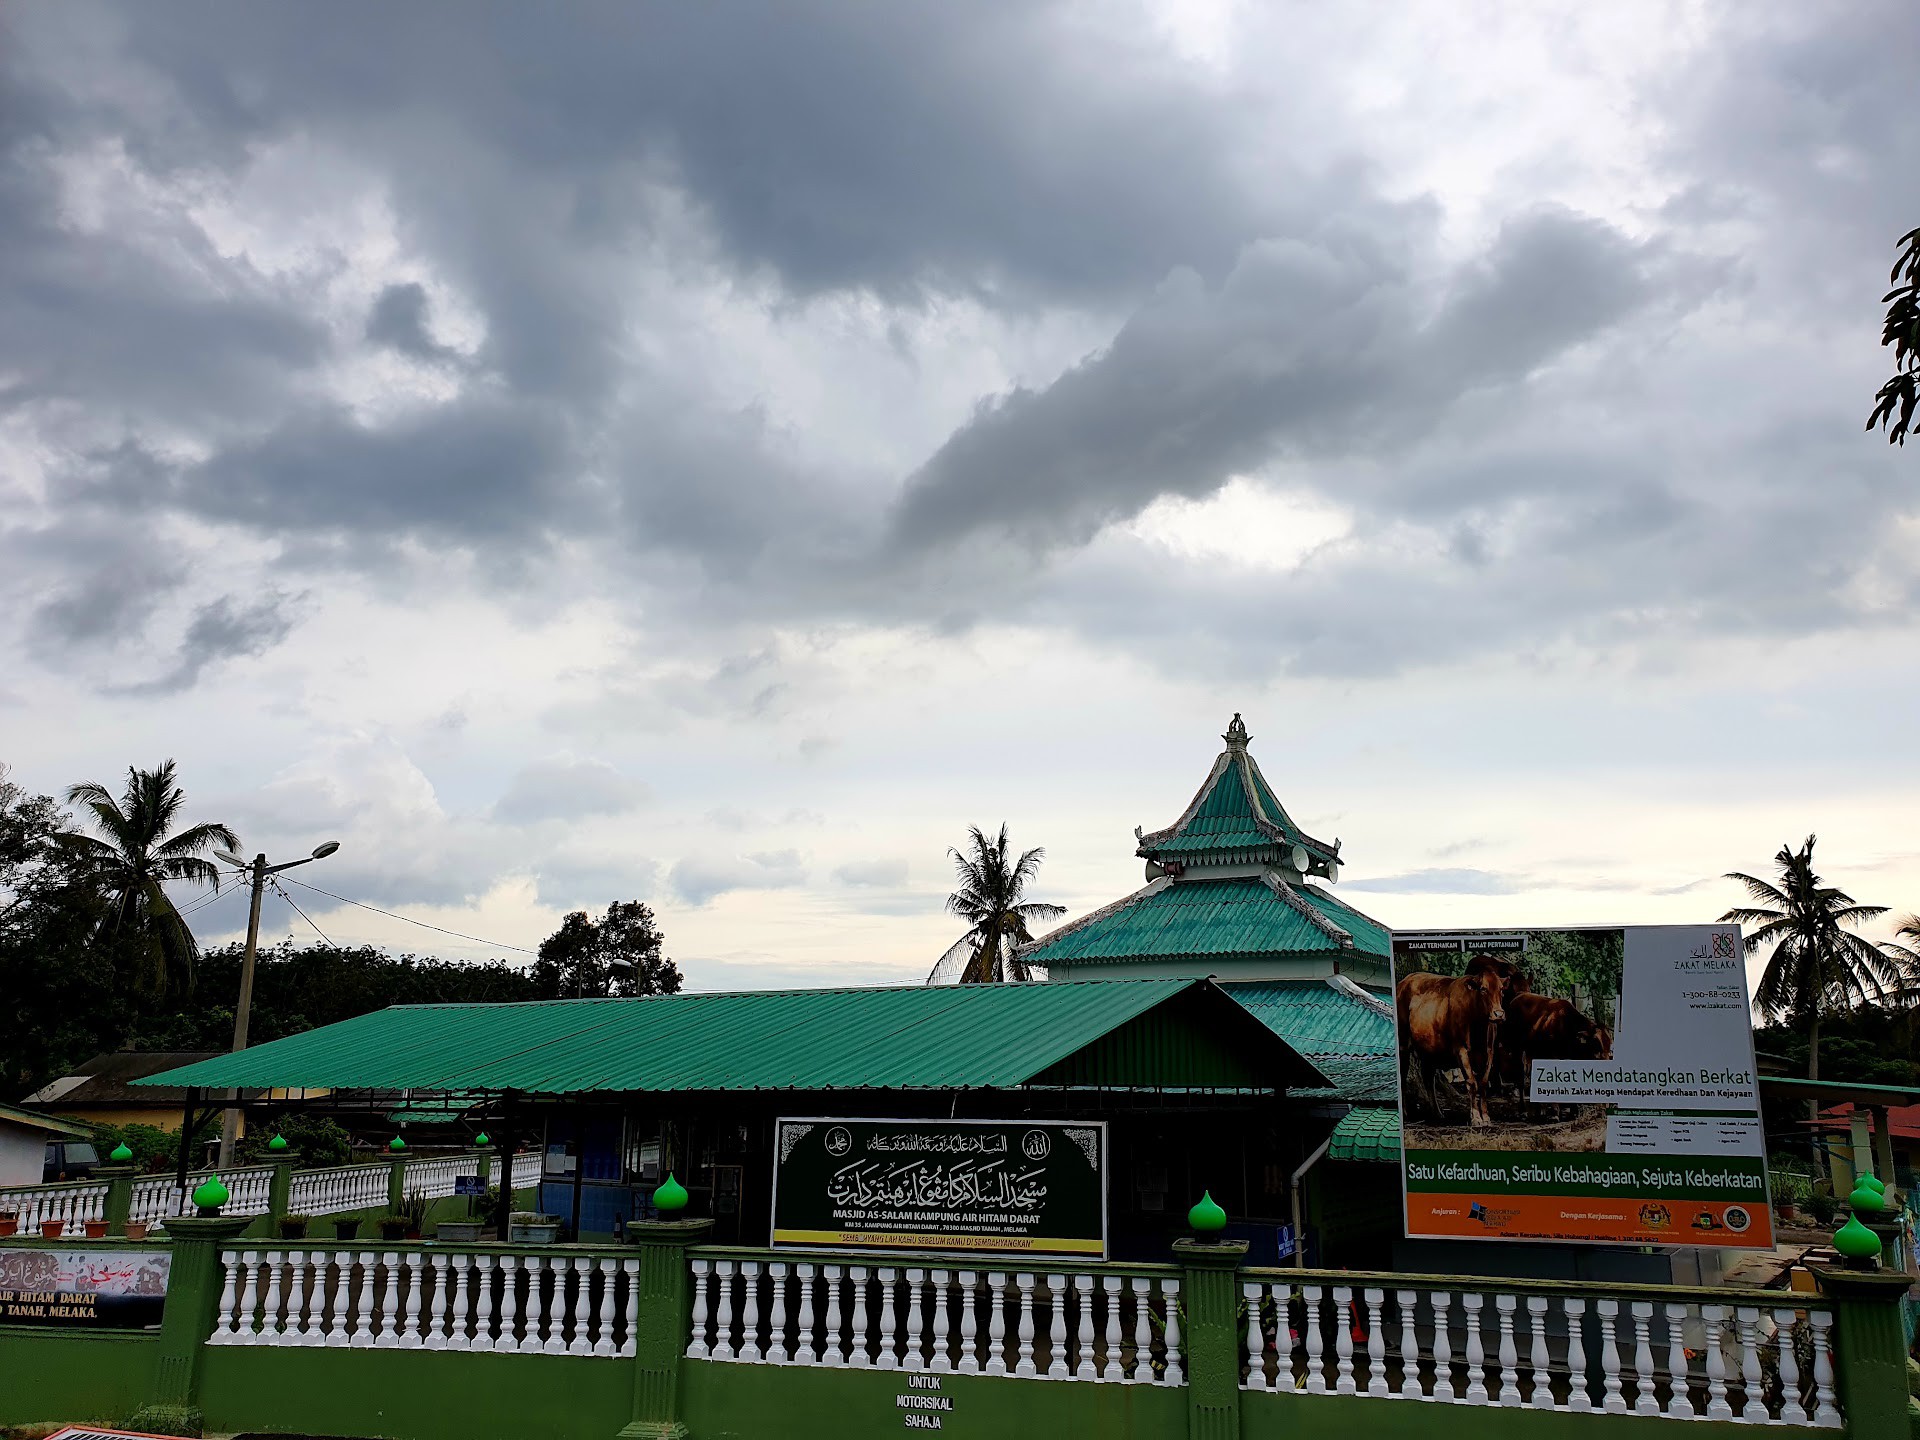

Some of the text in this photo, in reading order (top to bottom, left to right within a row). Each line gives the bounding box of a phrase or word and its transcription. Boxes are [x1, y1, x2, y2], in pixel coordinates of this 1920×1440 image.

[1674, 960, 1737, 970] ZAKAT MELAKA
[1682, 991, 1740, 999] 1-300-88-0233
[1536, 1067, 1752, 1086] Zakat Mendatangkan Berkat
[1571, 1087, 1593, 1096] Zakat
[1594, 1088, 1615, 1097] Moga
[1617, 1088, 1654, 1098] Mendapat
[1656, 1088, 1698, 1097] Keredhaan
[1700, 1089, 1715, 1097] Dan
[1717, 1089, 1753, 1099] Kejayaan
[1408, 1163, 1762, 1190] Satu Kefardhuan, Seribu Kebahagiaan, Sejuta Keberkatan
[833, 1209, 1040, 1224] MASJID AS-SALAM KAMPUNG AIR HITAM DARAT
[1560, 1211, 1623, 1222] Dengan Kerjasama
[917, 1236, 945, 1246] SEBELUM
[18, 1292, 55, 1303] HITAM
[60, 1293, 98, 1305] DARAT
[8, 1305, 47, 1318] TANAH,
[49, 1306, 98, 1319] MELAKA.
[909, 1376, 941, 1389] UNTUK
[896, 1395, 953, 1410] MOTORSIKAL
[905, 1414, 941, 1429] SAHAJA
